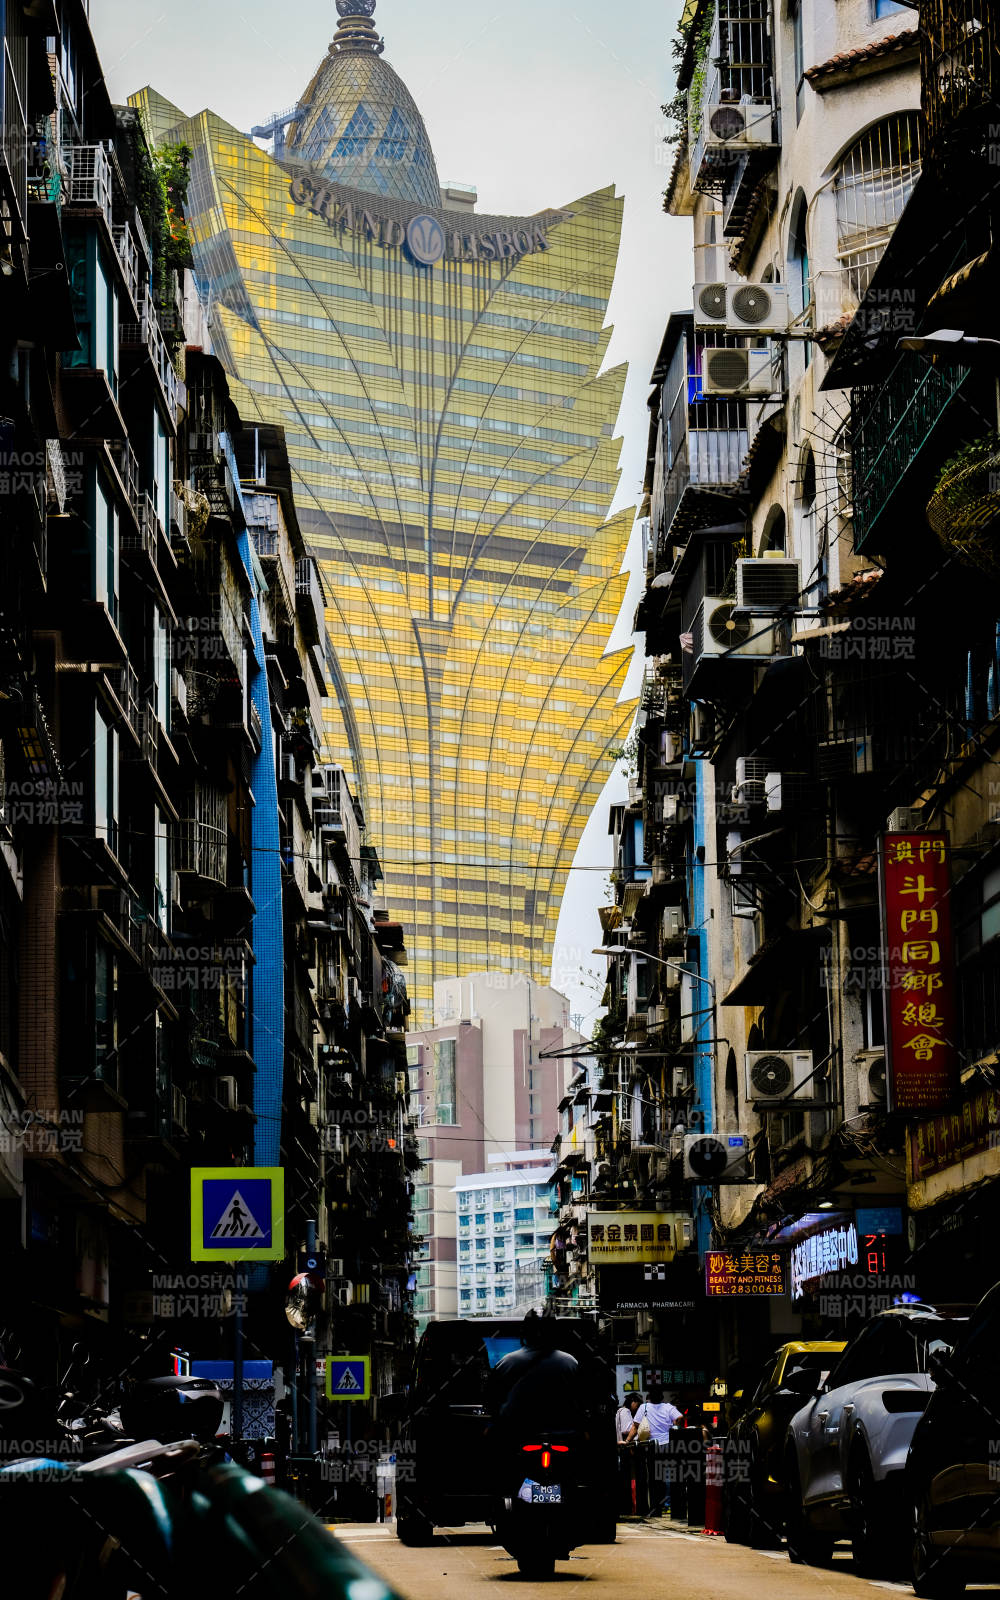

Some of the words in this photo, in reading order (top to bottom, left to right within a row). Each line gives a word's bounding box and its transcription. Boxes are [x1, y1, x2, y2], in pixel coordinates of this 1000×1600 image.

[289, 176, 405, 247] GRAND
[450, 223, 551, 261] LISBOA
[888, 839, 946, 865] 澳門
[898, 873, 948, 1061] 斗門同鄉總會
[709, 1276, 737, 1284] BEAUTY
[738, 1276, 753, 1284] AND
[755, 1275, 783, 1283] FITNESS
[540, 1485, 553, 1494] MG
